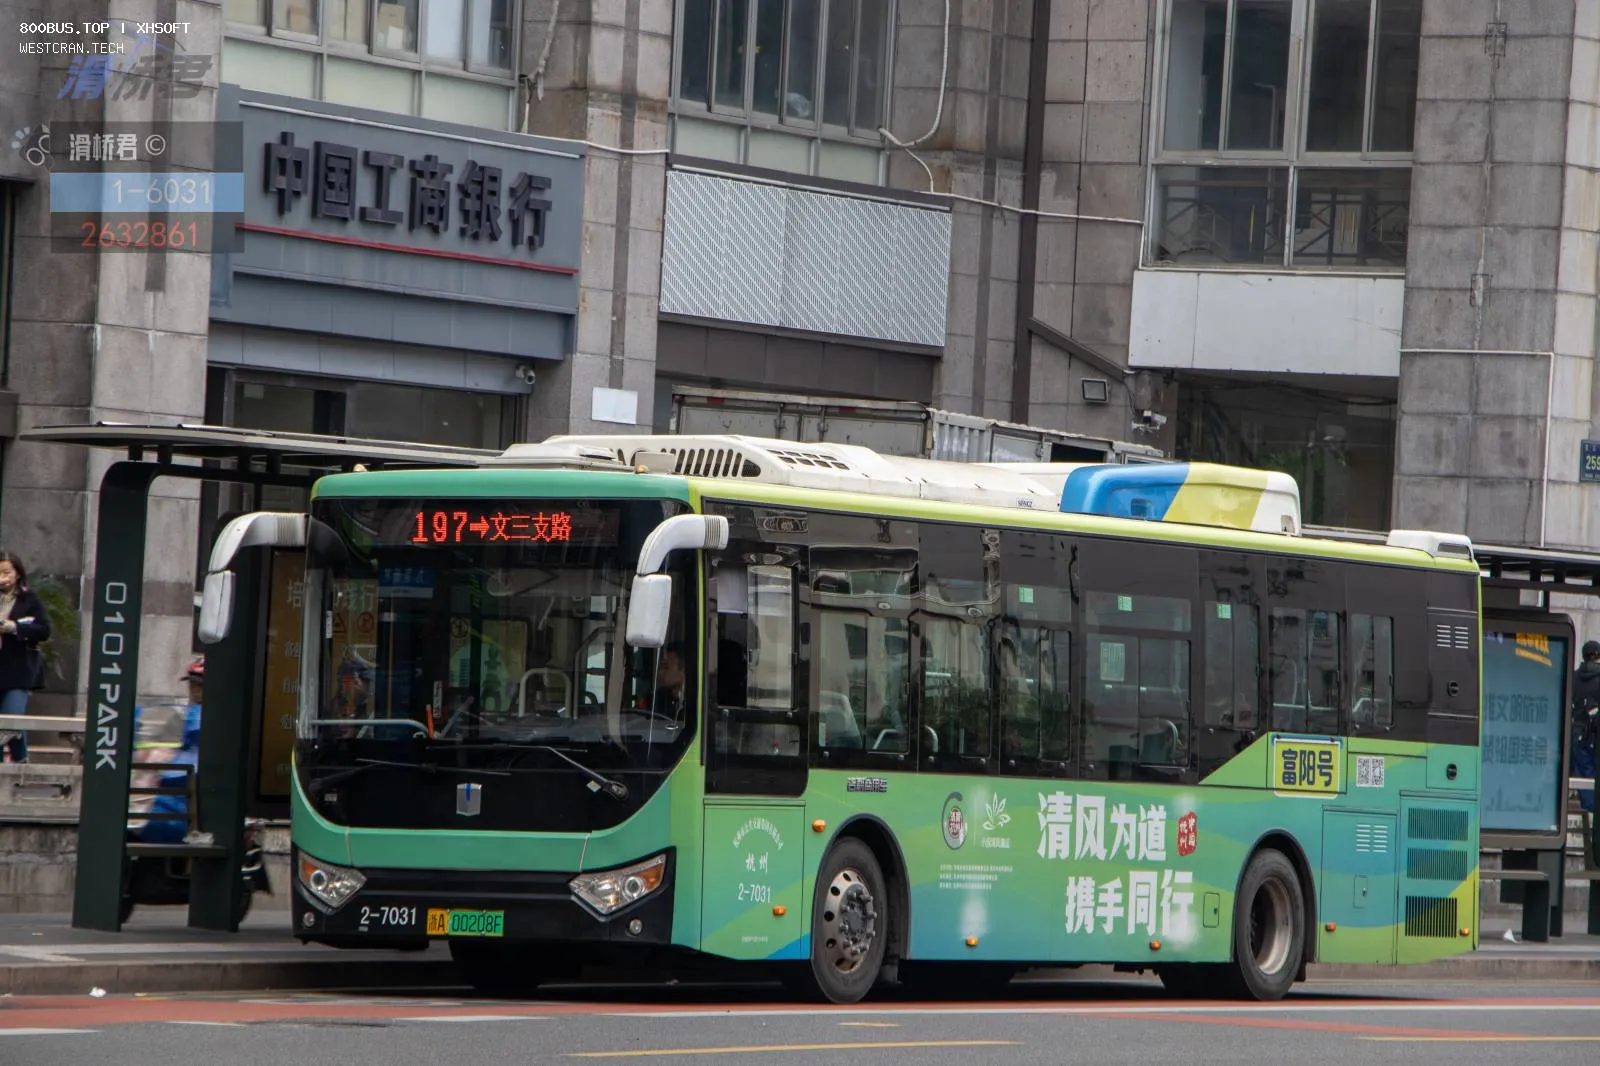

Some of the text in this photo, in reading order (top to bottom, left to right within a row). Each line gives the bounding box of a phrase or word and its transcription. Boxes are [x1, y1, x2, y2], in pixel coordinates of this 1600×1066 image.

[263, 131, 553, 250] 中国工商银行
[411, 511, 468, 543] 197
[489, 512, 572, 543] 文三支路
[95, 582, 127, 771] 0101PARK
[1281, 748, 1334, 787] 富阳号
[1036, 791, 1167, 861] 清风为道
[737, 883, 772, 903] 2-7031
[1065, 869, 1195, 937] 携手同行
[360, 906, 417, 926] 2-7031
